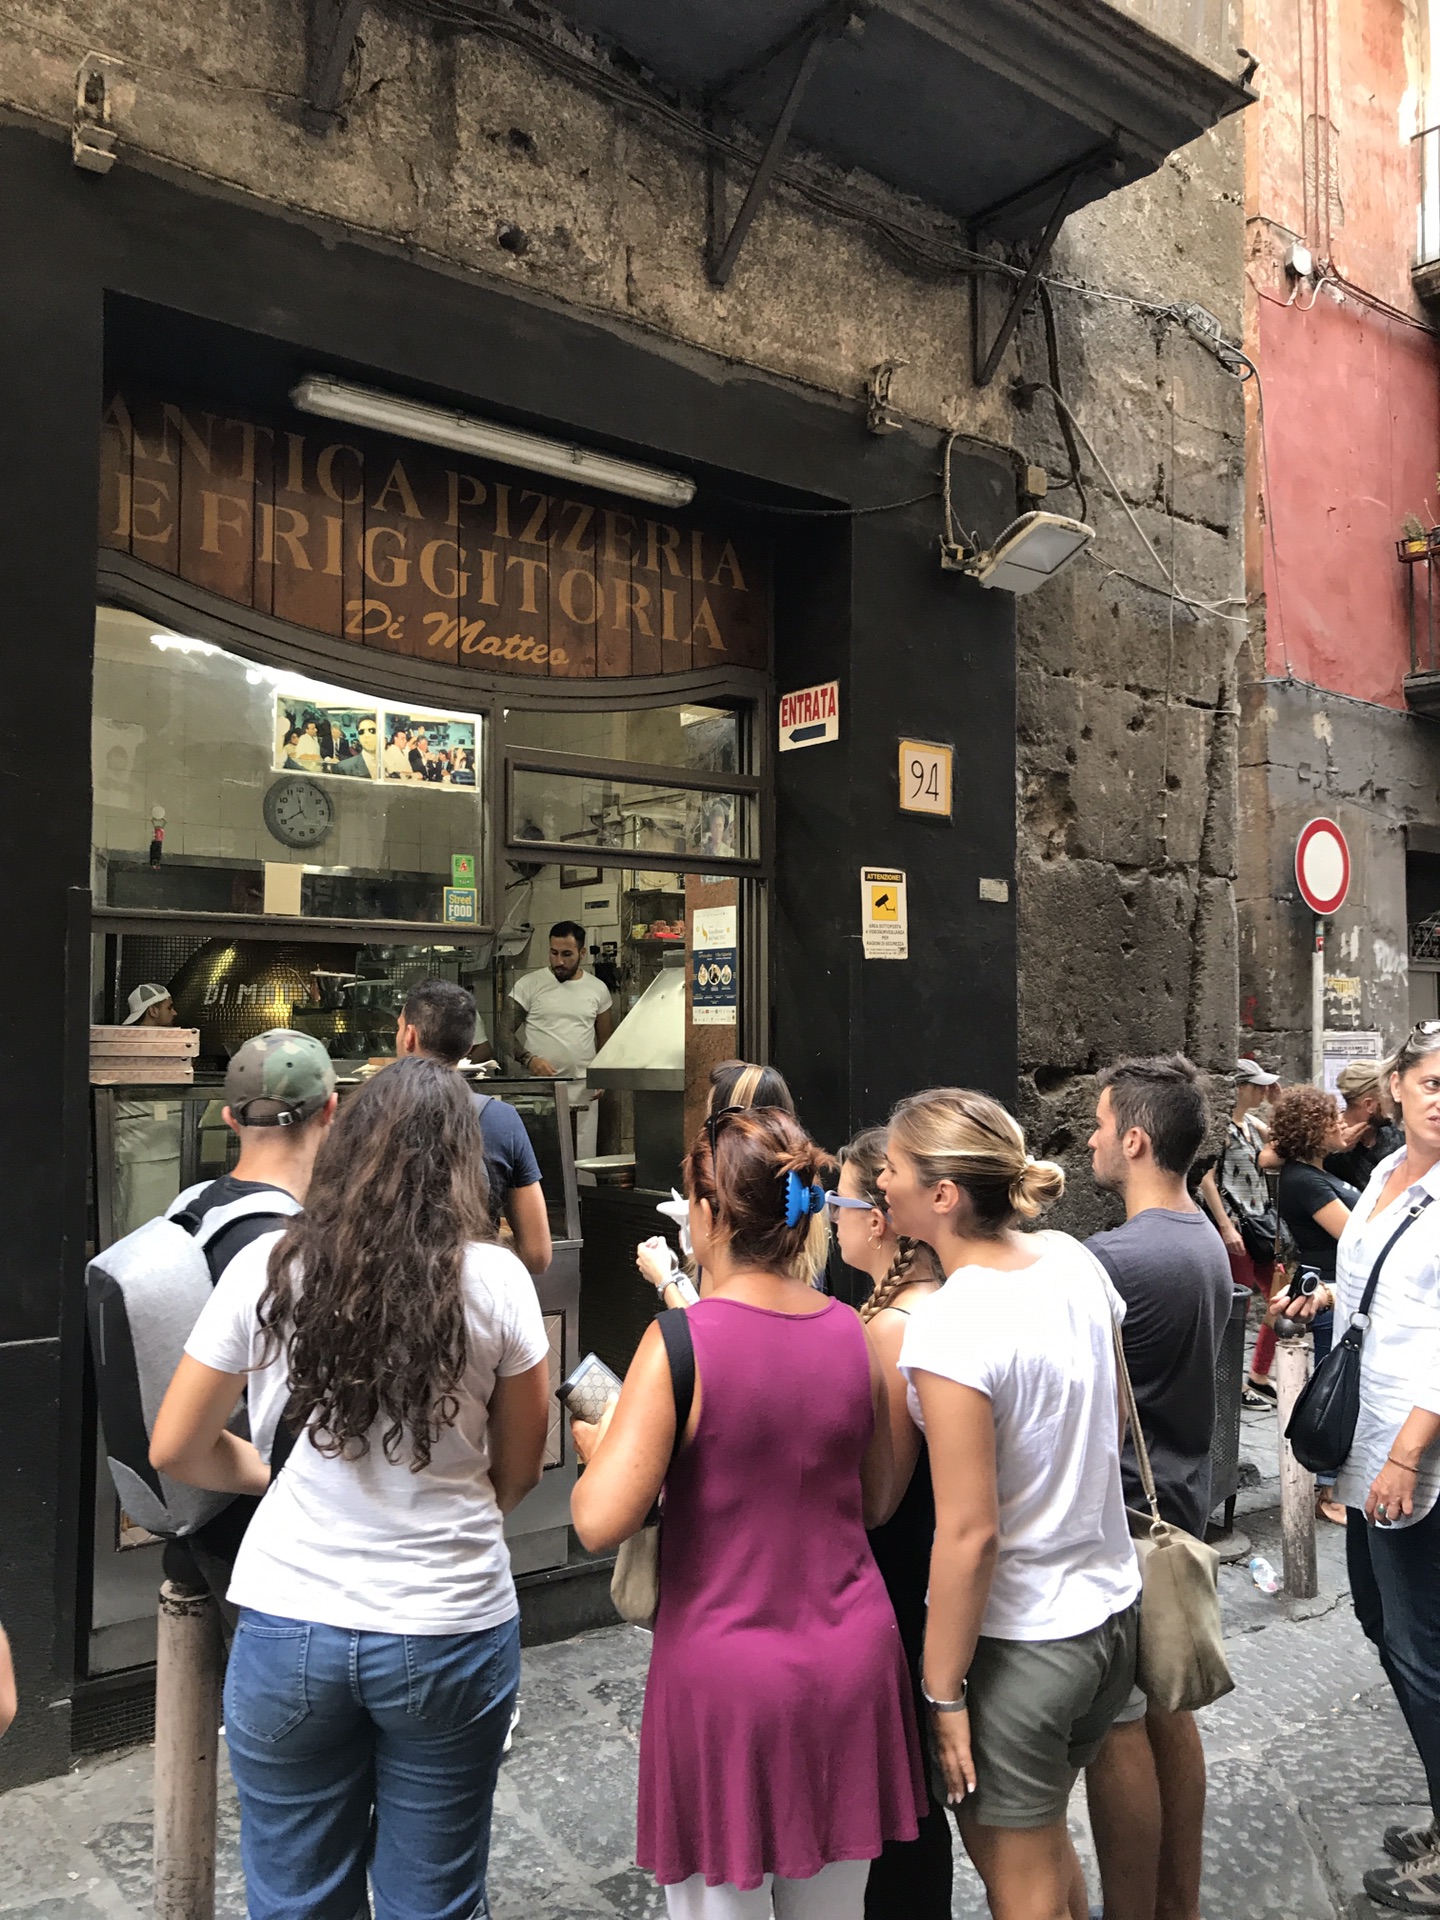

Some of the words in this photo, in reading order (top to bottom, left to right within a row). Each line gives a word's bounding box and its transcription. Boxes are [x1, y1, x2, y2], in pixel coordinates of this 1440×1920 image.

[102, 391, 426, 520] ANTICA
[445, 470, 749, 592] PIZZERIA
[112, 472, 174, 544] E
[200, 490, 728, 651] FRIGGITORIA
[345, 598, 404, 639] Di
[422, 611, 570, 666] Matteo
[781, 686, 836, 728] ENTRATA
[911, 760, 939, 801] 94
[448, 893, 472, 905] Street
[448, 904, 473, 917] FOOD
